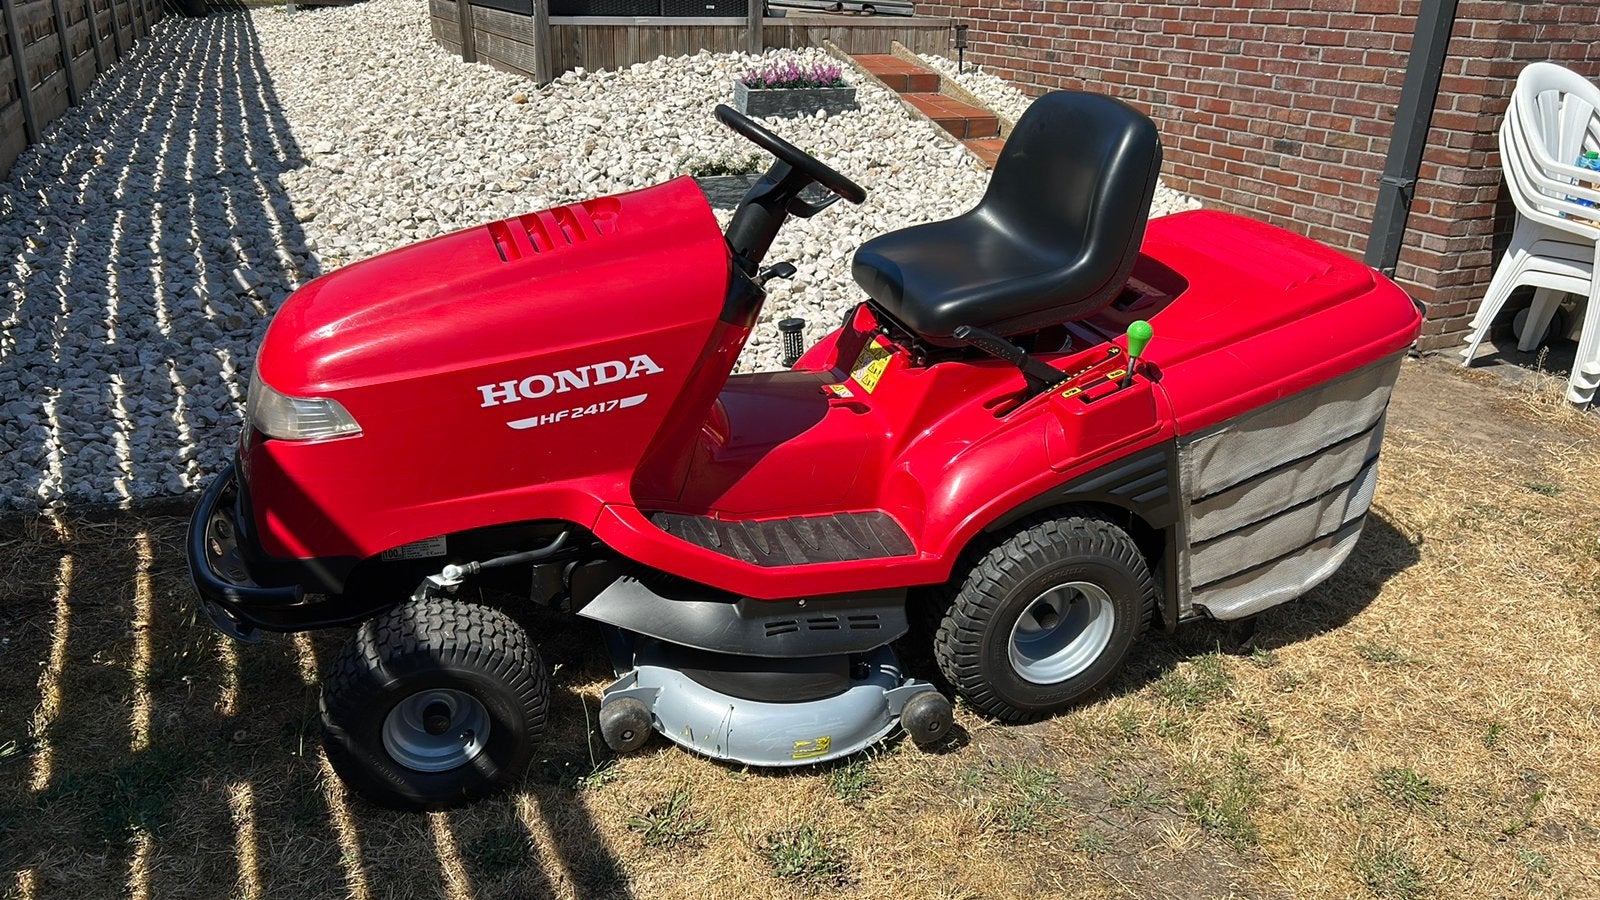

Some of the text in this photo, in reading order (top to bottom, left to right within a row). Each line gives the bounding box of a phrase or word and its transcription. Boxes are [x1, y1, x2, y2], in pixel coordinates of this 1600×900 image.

[477, 354, 664, 408] HONDA
[540, 399, 619, 426] HF 2417
